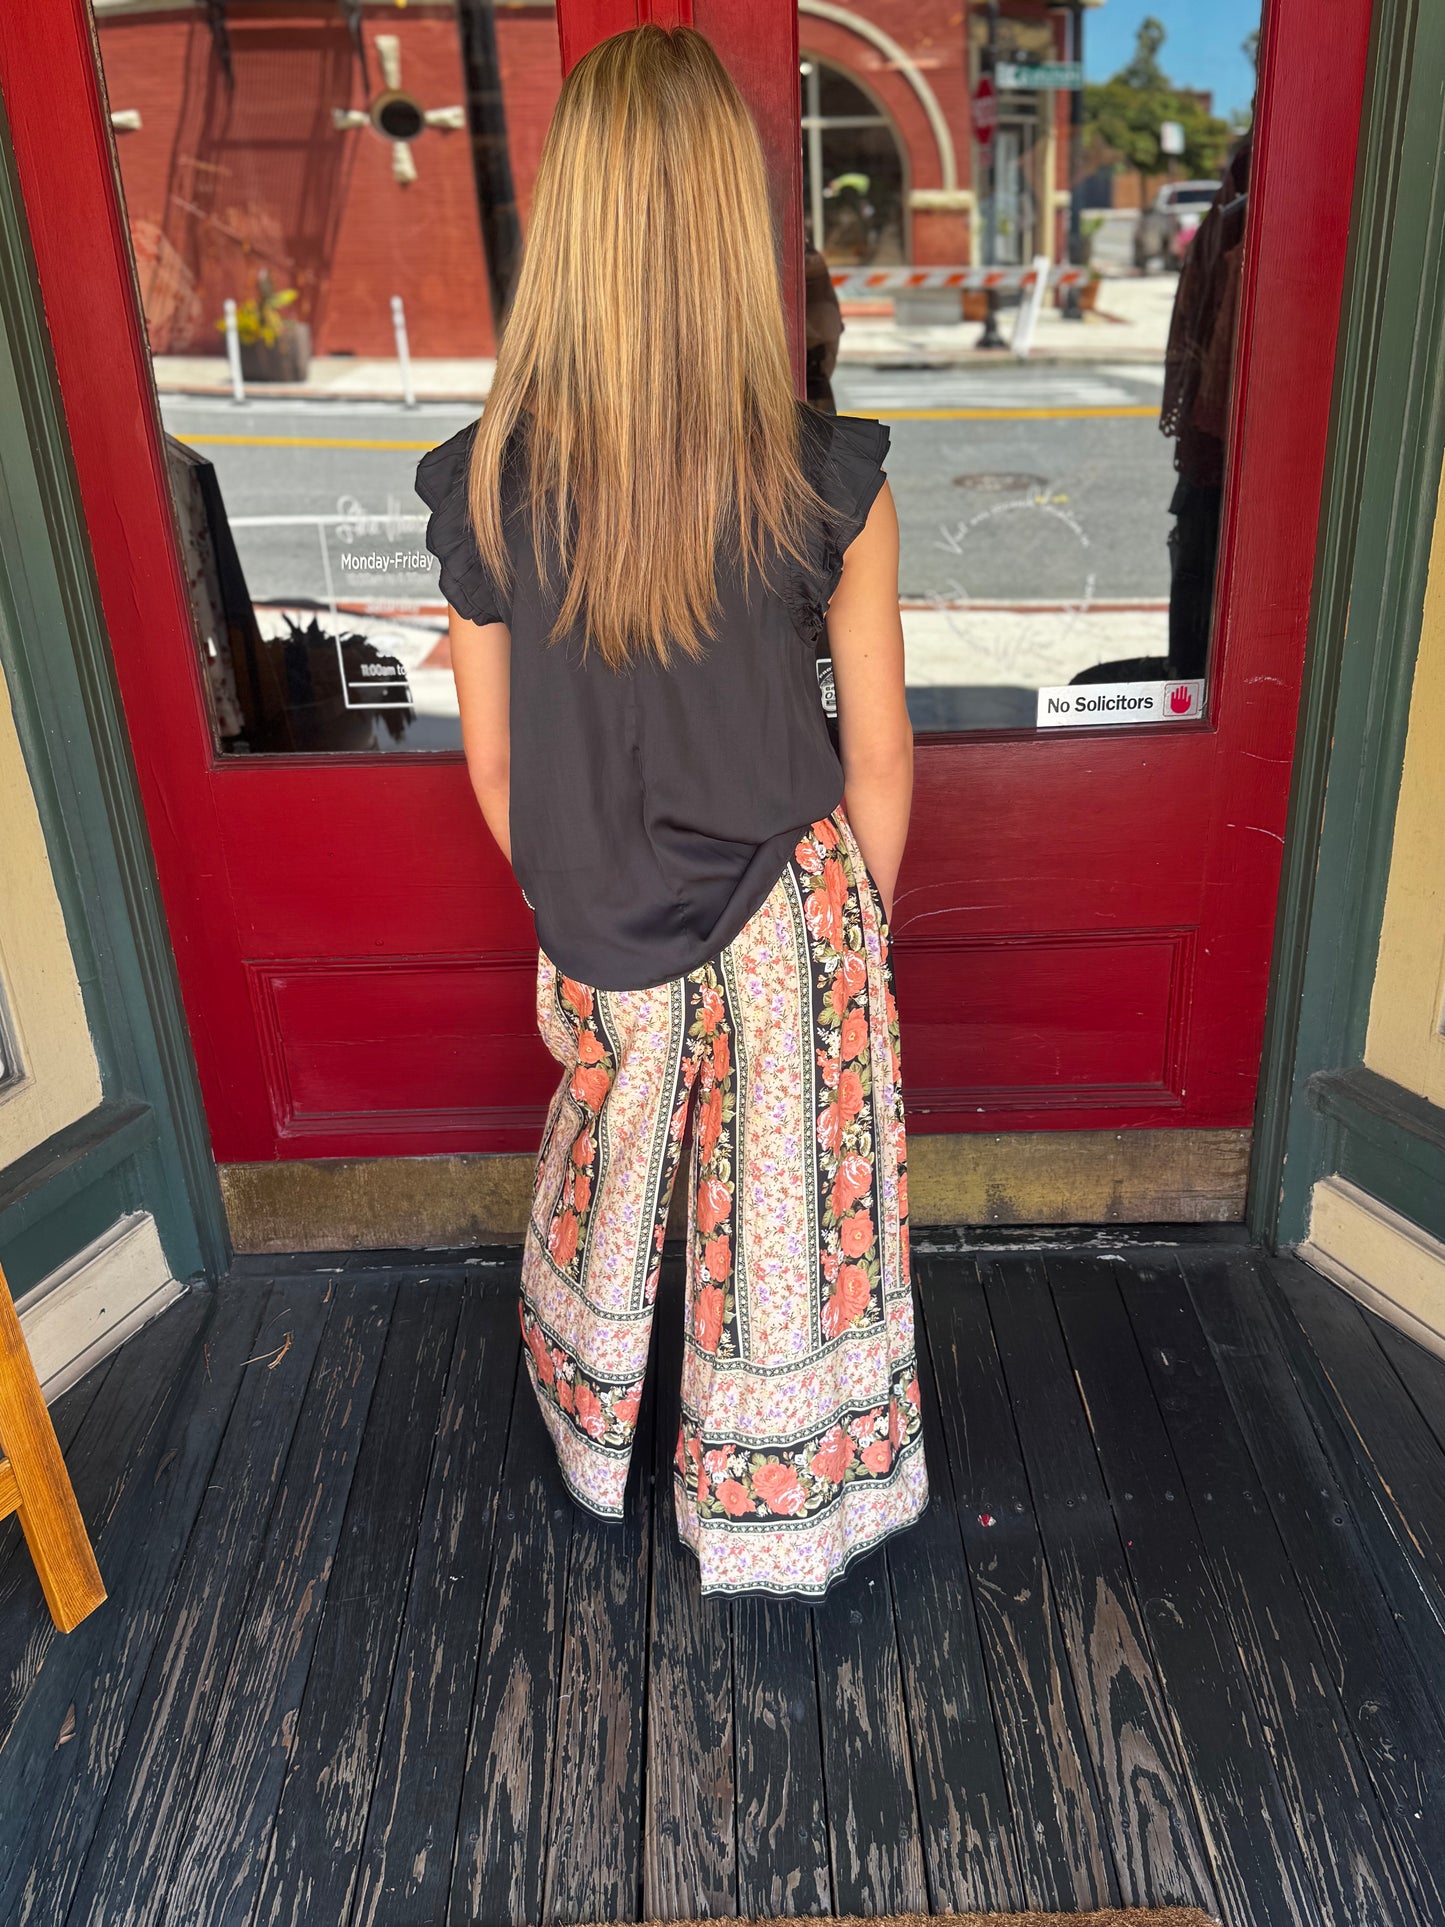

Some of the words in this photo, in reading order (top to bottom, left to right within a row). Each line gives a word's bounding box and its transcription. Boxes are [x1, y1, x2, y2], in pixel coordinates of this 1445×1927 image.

[340, 551, 434, 572] Monday-Friday
[1047, 698, 1070, 714] No
[1074, 694, 1153, 712] Solicitors
